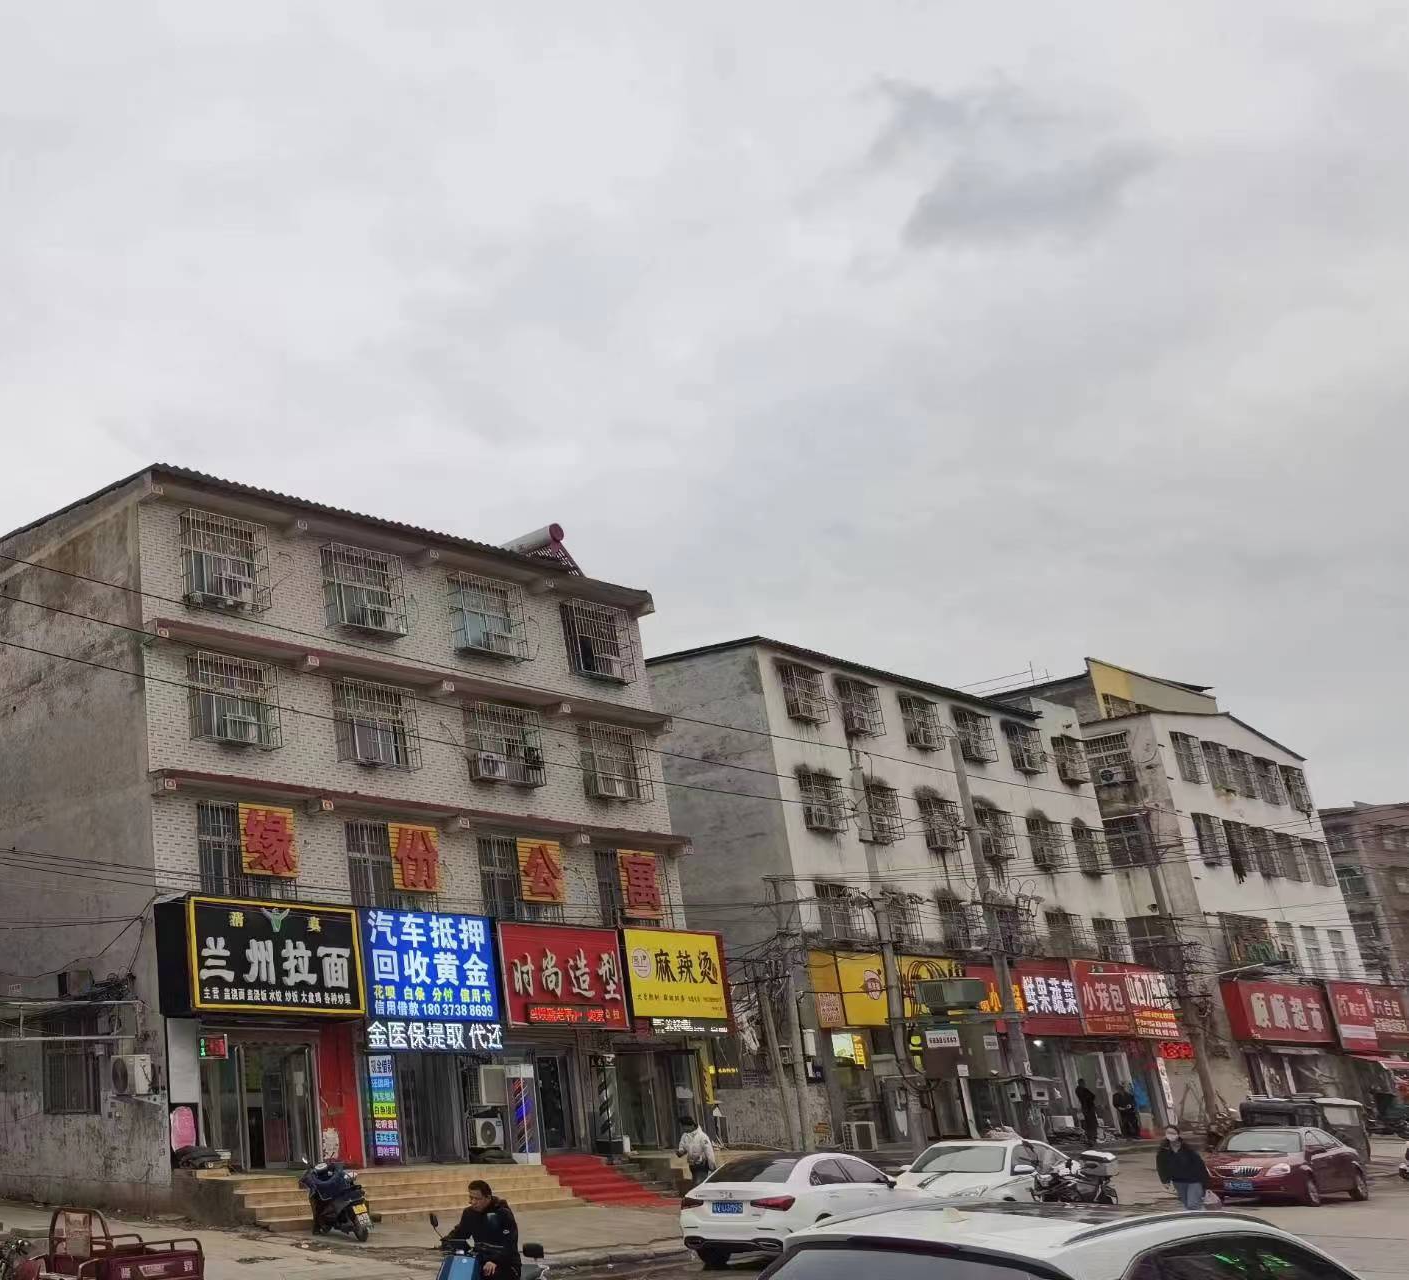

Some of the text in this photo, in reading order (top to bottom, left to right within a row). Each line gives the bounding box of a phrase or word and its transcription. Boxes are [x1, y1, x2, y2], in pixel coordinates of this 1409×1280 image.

[368, 911, 485, 952] 汽车抵押
[199, 936, 350, 989] 兰州拉面
[372, 949, 490, 986] 回收黄金
[513, 947, 622, 1000] 时尚造型
[654, 948, 718, 985] 麻辣烫
[203, 987, 220, 1000] 主营
[374, 985, 491, 1003] 花呗 白条 分付 信用卡
[375, 1000, 493, 1017] 信用借款 180 3738 8699
[1022, 976, 1079, 1014] 鲜果蔬菜
[1082, 981, 1126, 1011] 小笼包
[367, 1020, 503, 1050] 金医保提取 代还
